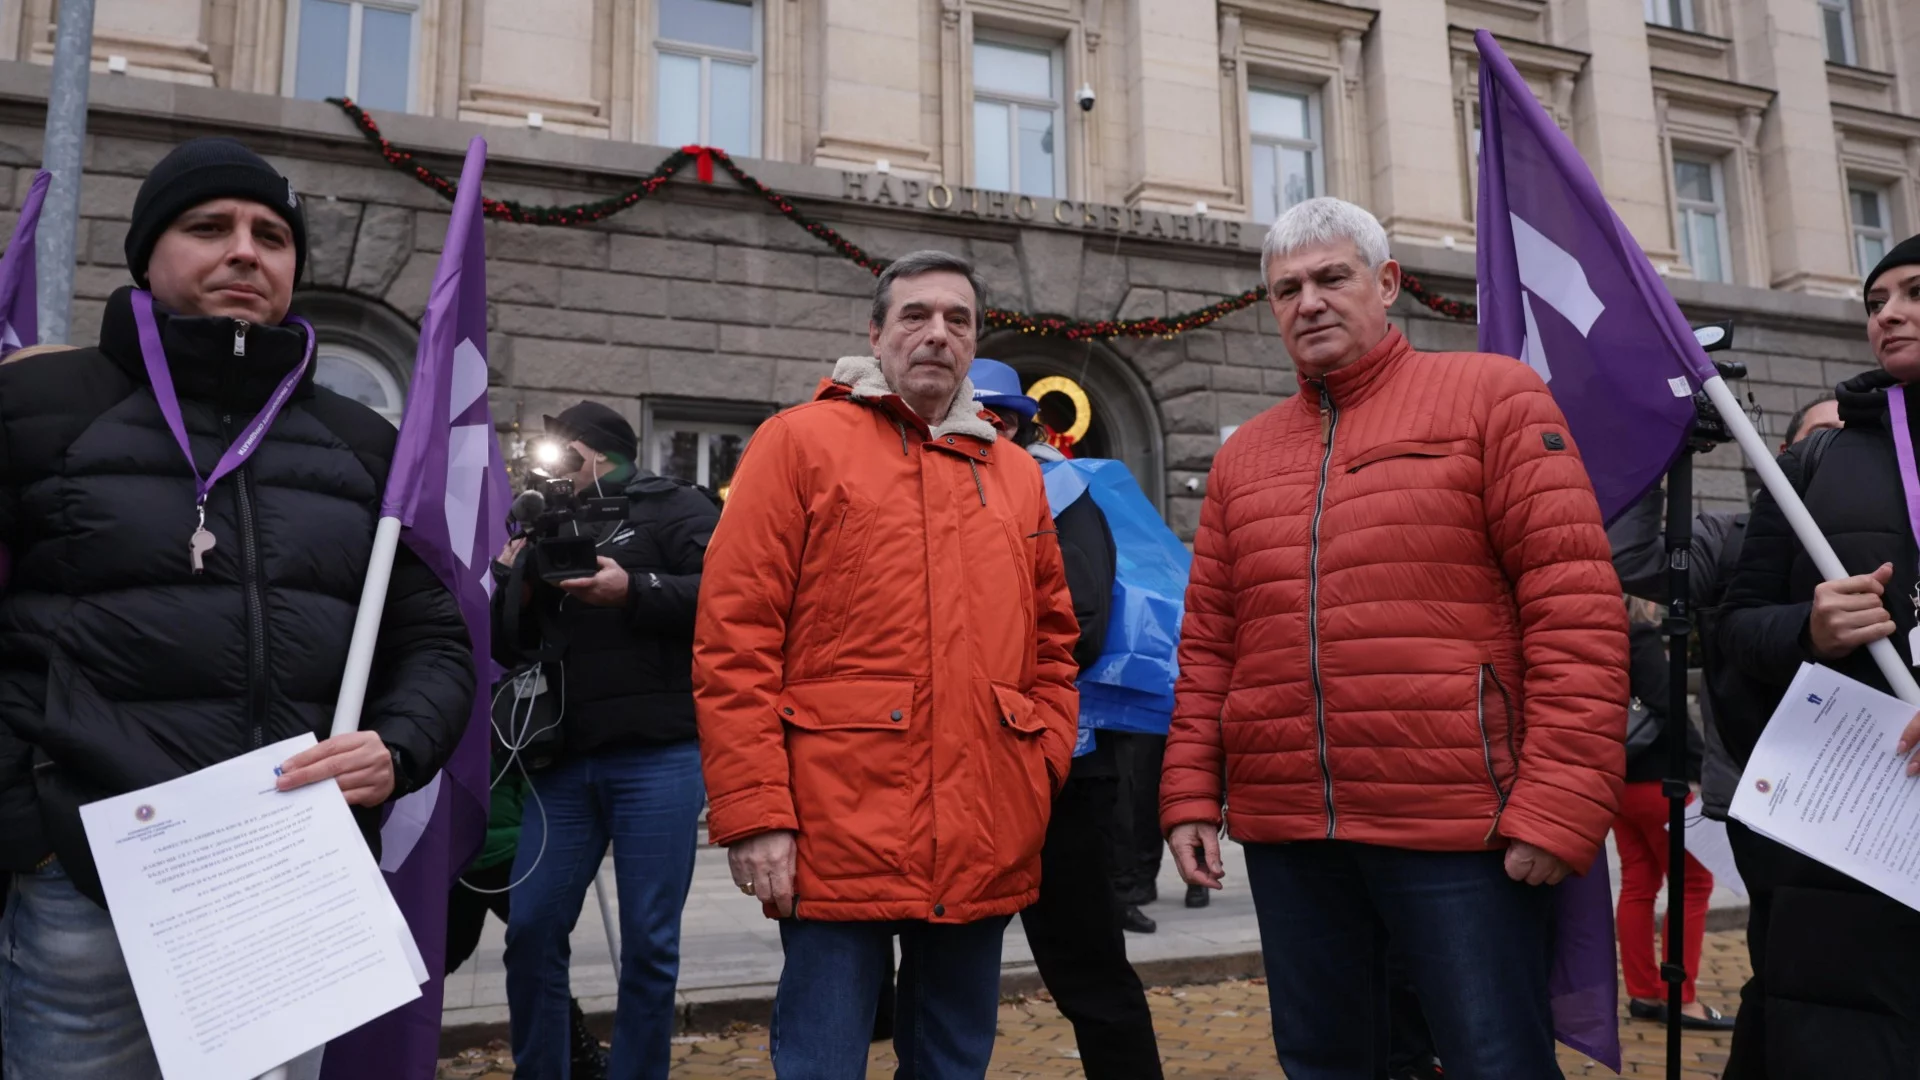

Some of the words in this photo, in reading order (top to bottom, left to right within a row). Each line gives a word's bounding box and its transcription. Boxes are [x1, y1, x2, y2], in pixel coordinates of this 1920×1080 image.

[842, 171, 1038, 222] НАРОДНО
[1053, 199, 1243, 247] СЪБРАНИЕ
[237, 422, 265, 456] СИНДИКАТИ
